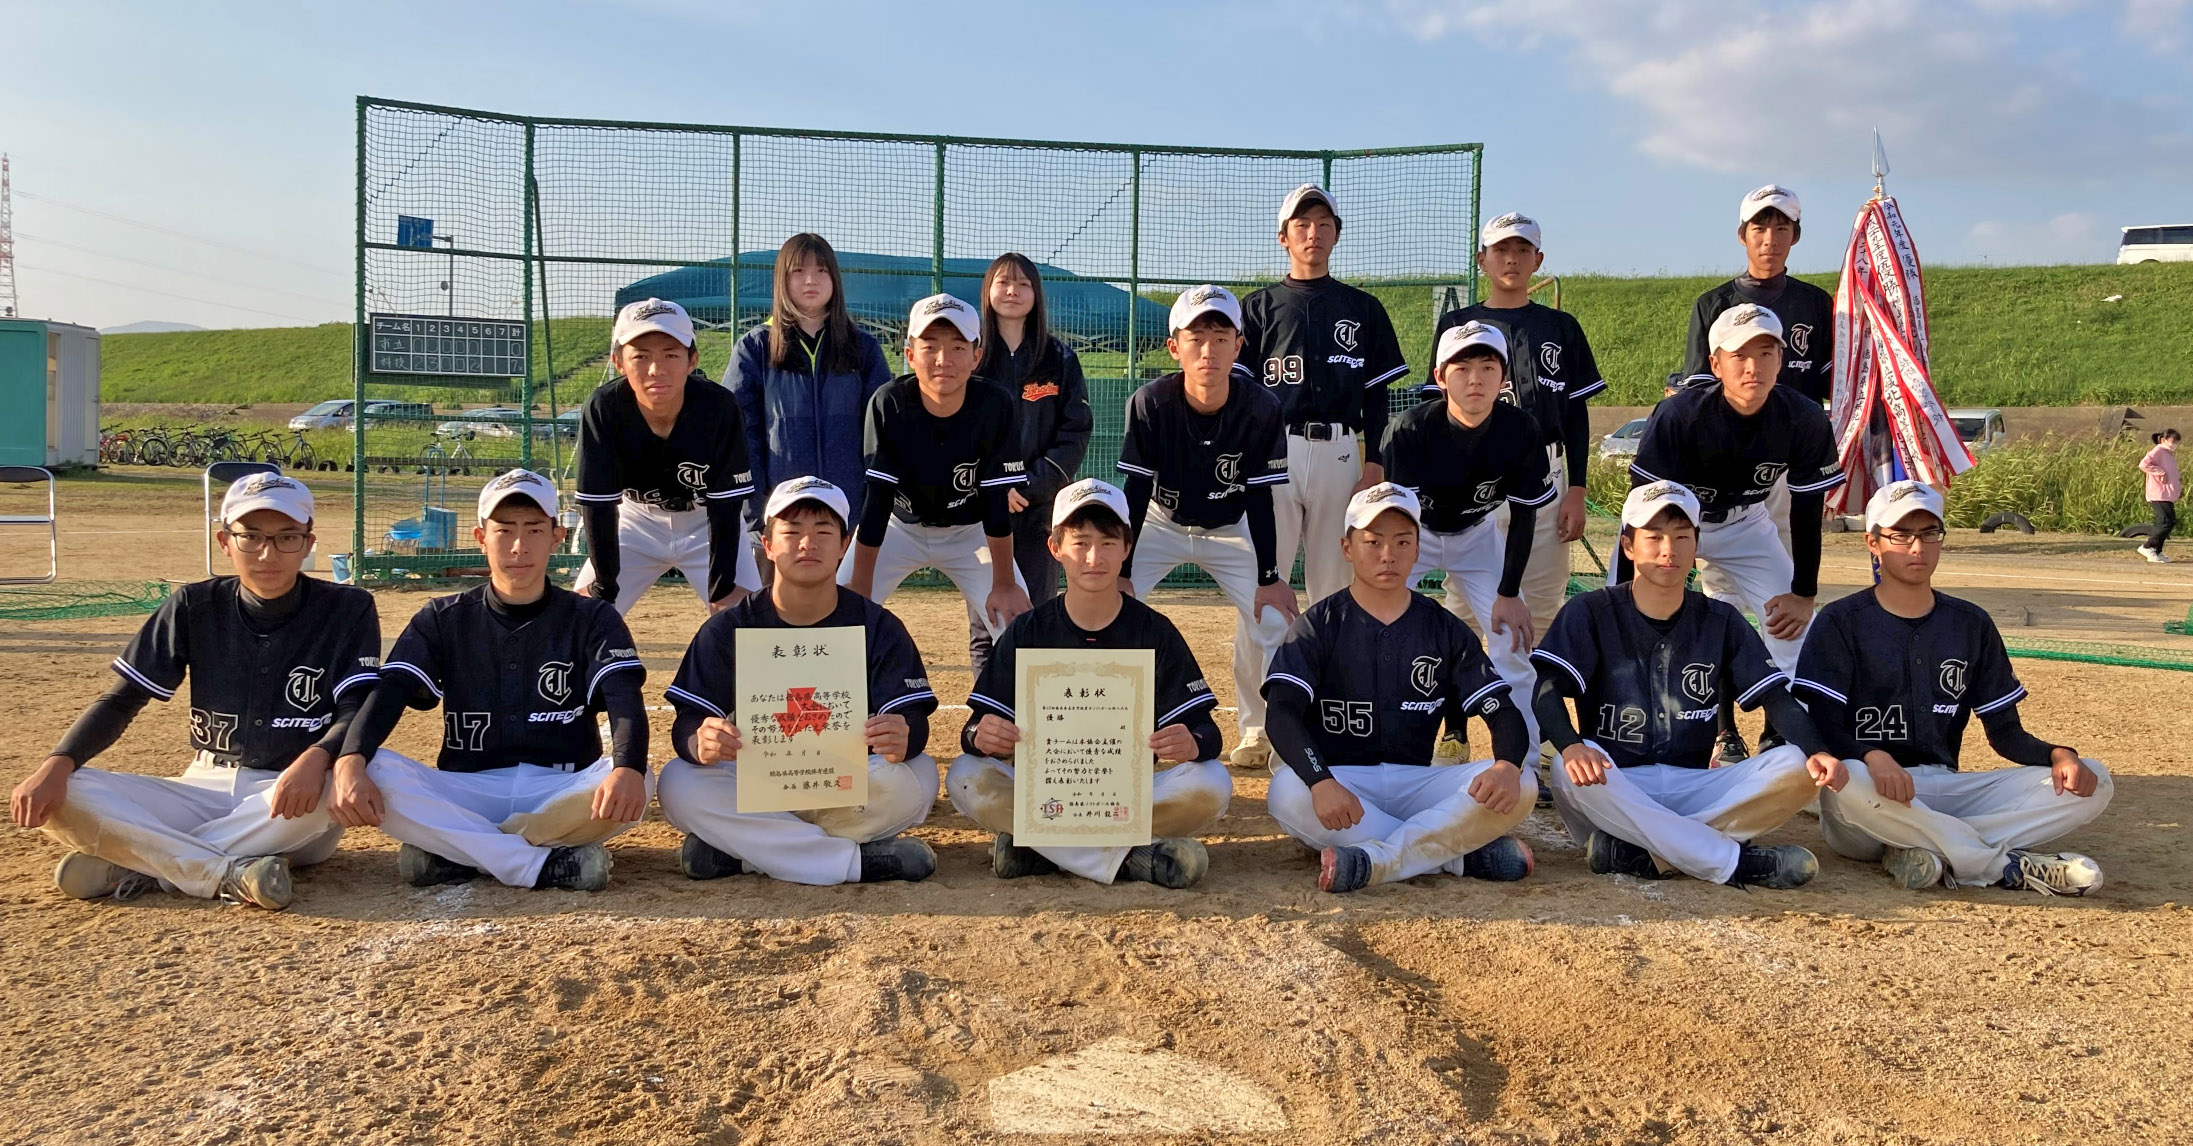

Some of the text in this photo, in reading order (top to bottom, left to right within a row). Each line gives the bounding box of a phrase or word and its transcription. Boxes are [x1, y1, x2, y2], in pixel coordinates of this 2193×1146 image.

[376, 321, 411, 332] チーム名
[430, 324, 436, 332] 2
[457, 326, 464, 334] 4
[512, 327, 521, 336] 計
[511, 342, 521, 356] 0
[380, 356, 409, 370] 科技
[414, 356, 424, 370] 2
[427, 357, 439, 370] 3
[470, 359, 481, 371] 2
[1263, 355, 1304, 387] 99
[772, 644, 830, 658] 表彰状
[1063, 686, 1106, 698] 表彰状
[801, 700, 850, 710] 大会において
[1046, 713, 1064, 721] 優勝
[1320, 699, 1373, 738] 55
[1596, 703, 1646, 743] 12
[1855, 704, 1907, 741] 24
[190, 707, 239, 751] 37
[445, 712, 491, 751] 17
[752, 735, 794, 745] 表彰します
[763, 750, 777, 758] 令和
[801, 749, 806, 757] 月
[1042, 803, 1064, 813] TSA
